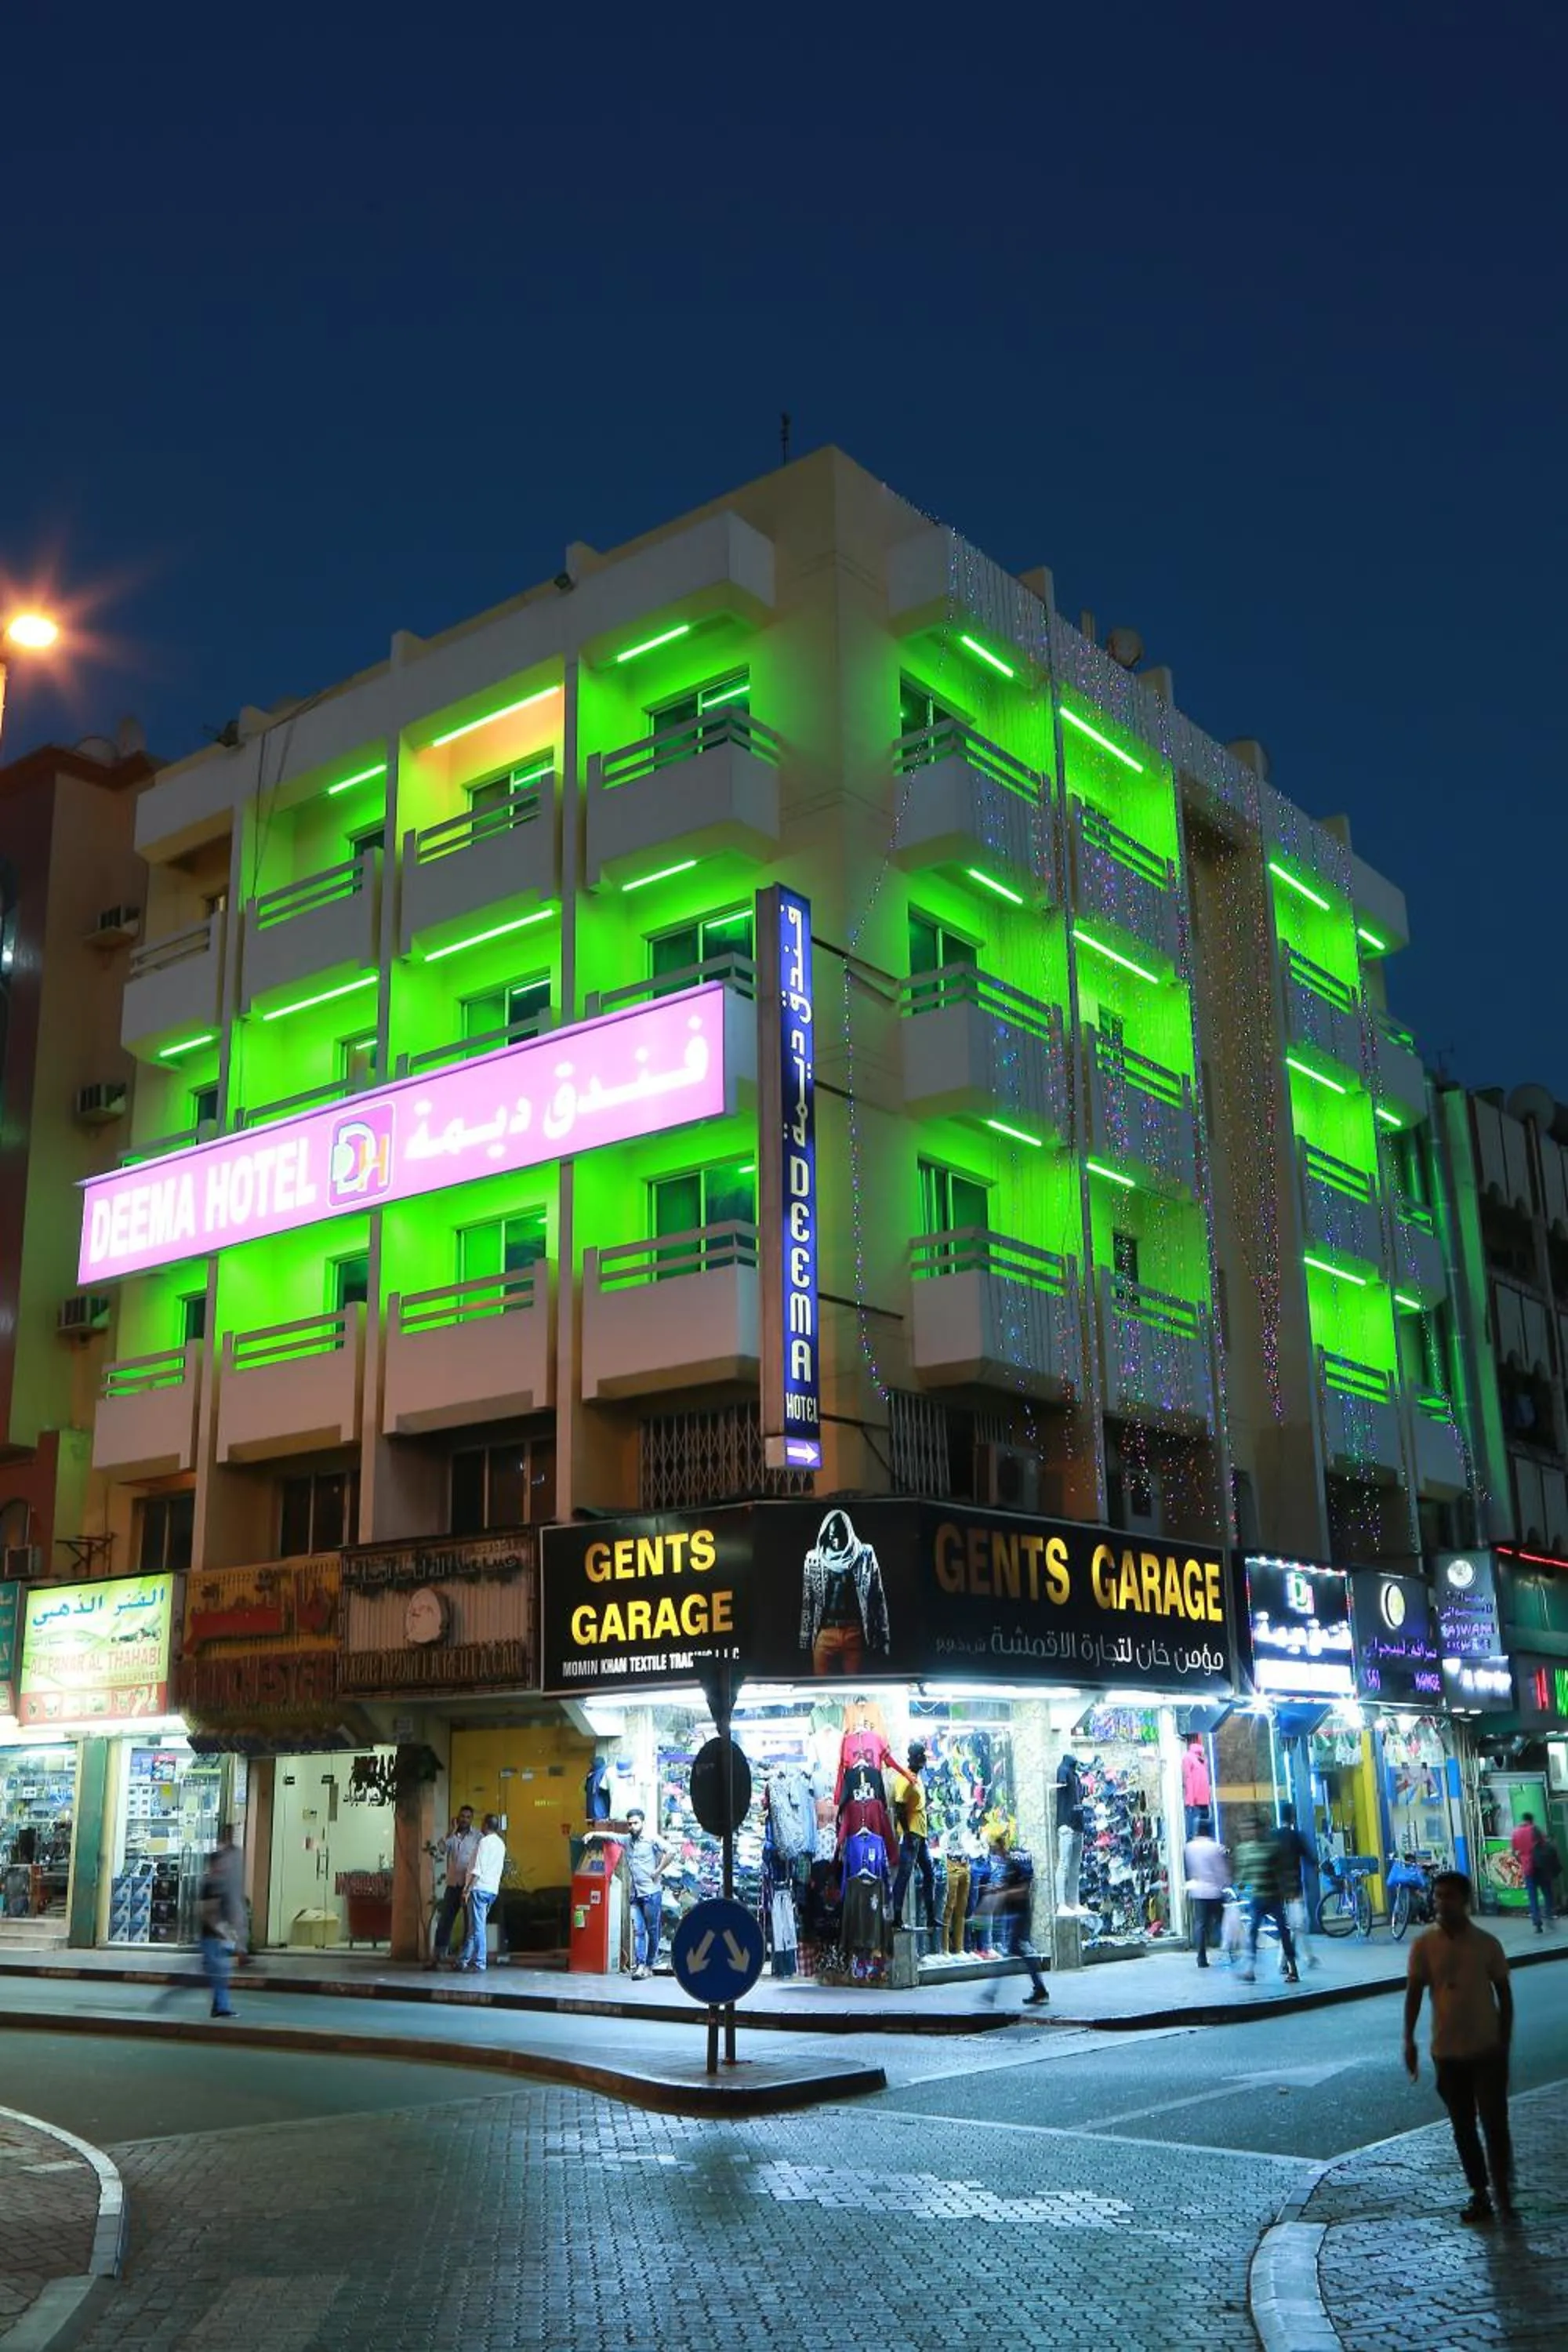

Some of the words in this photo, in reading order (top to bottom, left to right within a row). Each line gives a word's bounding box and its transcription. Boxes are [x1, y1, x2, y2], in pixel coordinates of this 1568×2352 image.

[779, 904, 813, 1024] فندق
[543, 1014, 710, 1140] فندق
[403, 1098, 532, 1160] ديمة
[89, 1171, 197, 1264] DEEMA
[204, 1136, 318, 1233] HOTEL
[789, 1156, 812, 1384] DEEMA
[786, 1392, 819, 1423] HOTEL
[584, 1529, 717, 1584] GENTS
[934, 1523, 1071, 1605] GENTS
[1091, 1543, 1225, 1623] GARAGE
[32, 1593, 103, 1633] الذهبي
[570, 1590, 734, 1646] GARAGE
[108, 1647, 162, 1670] THAHABI
[562, 1660, 598, 1677] MOMIN
[601, 1657, 628, 1674] KHAN
[630, 1653, 666, 1672] TEXTILE
[669, 1649, 713, 1669] TRAD
[1080, 1633, 1133, 1668] لتجارة
[1135, 1638, 1171, 1671] خان
[1174, 1642, 1225, 1676] مؤمن
